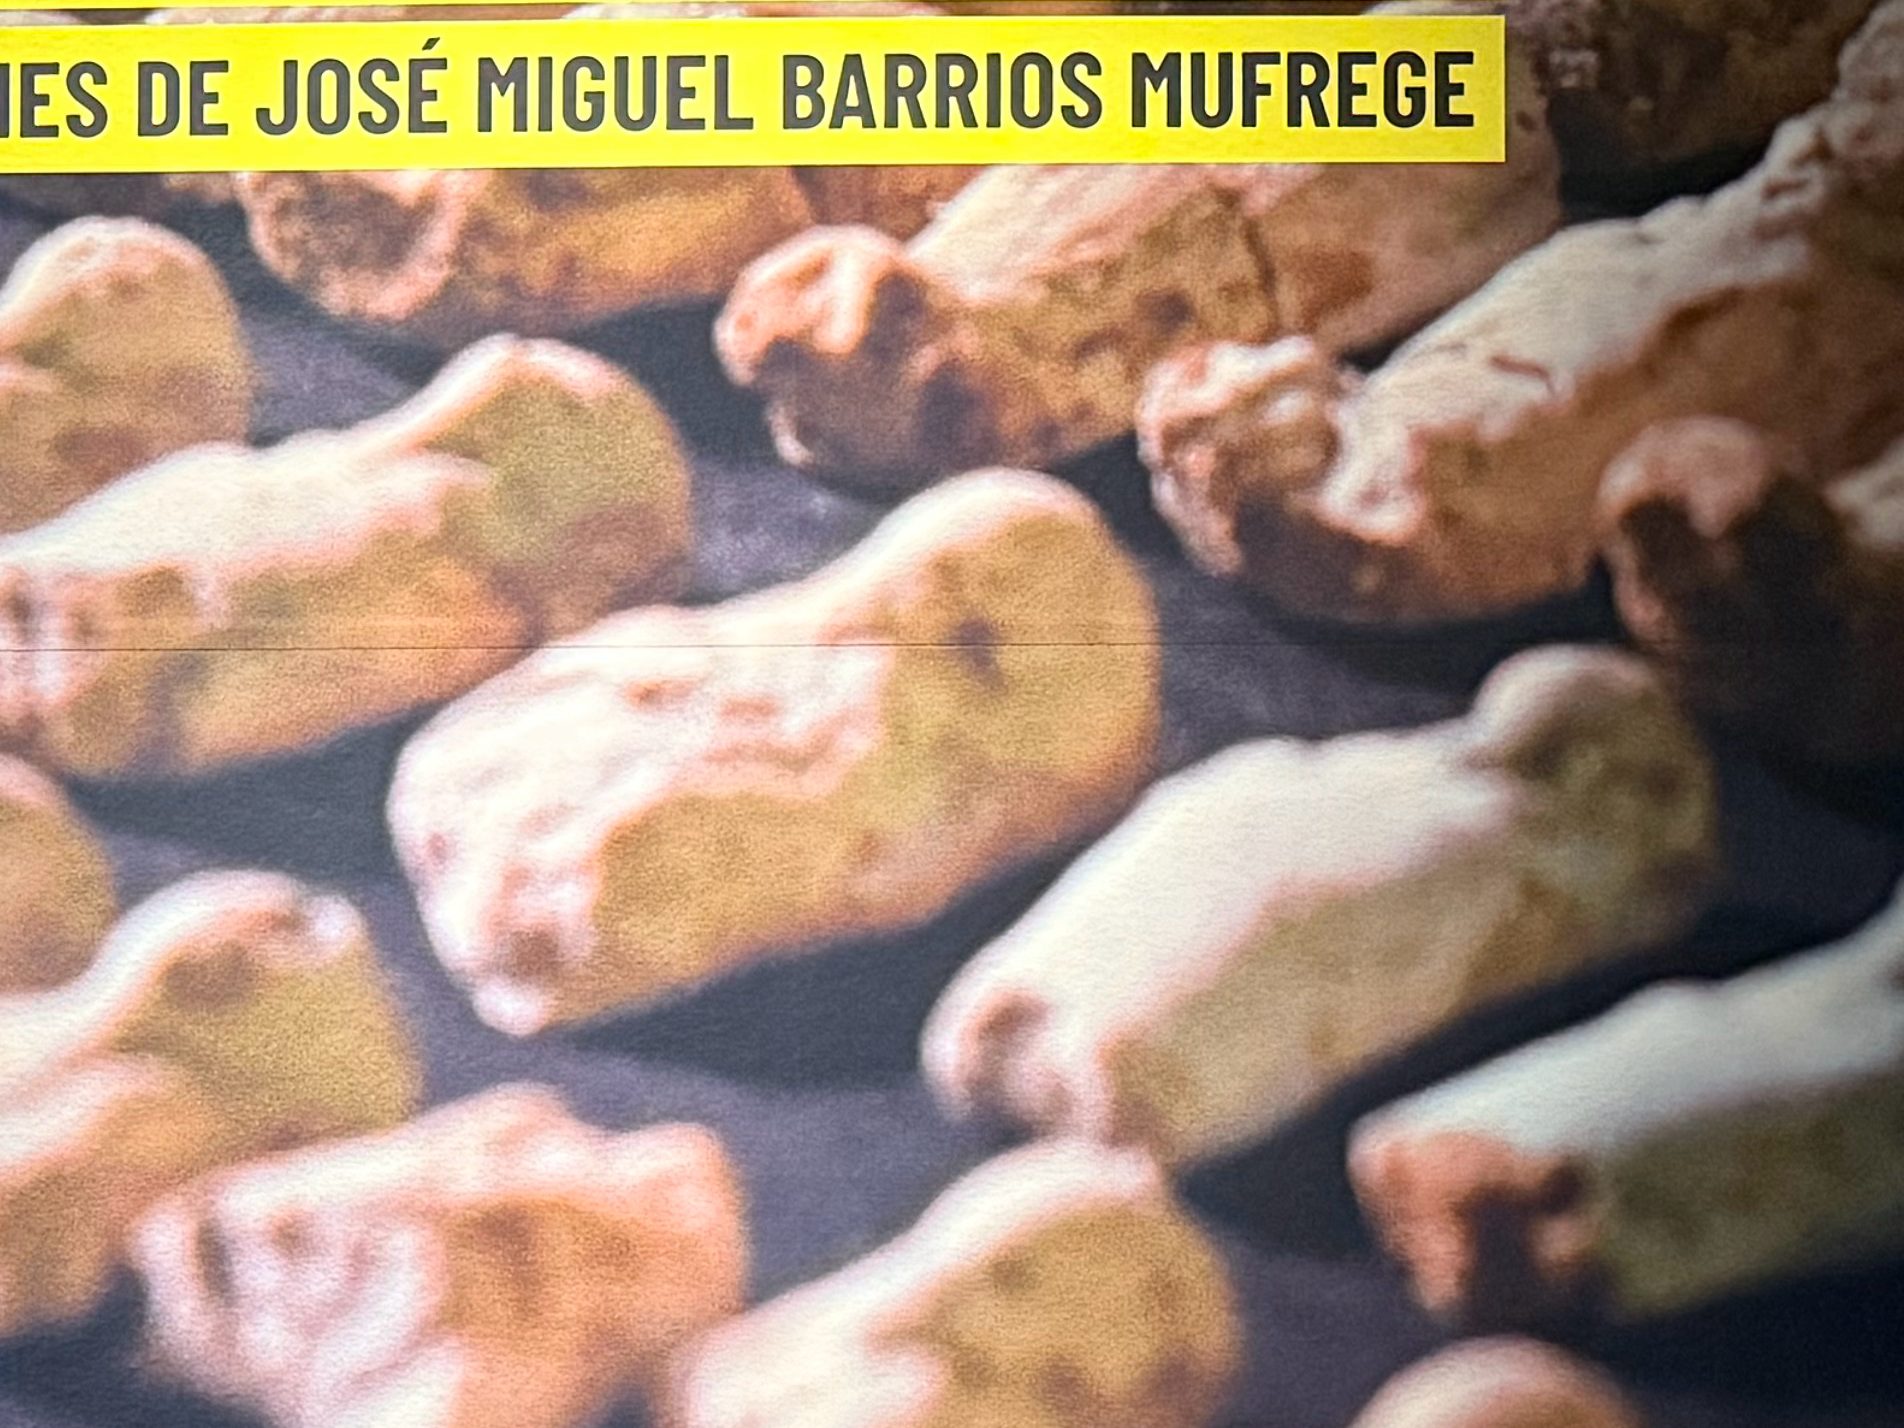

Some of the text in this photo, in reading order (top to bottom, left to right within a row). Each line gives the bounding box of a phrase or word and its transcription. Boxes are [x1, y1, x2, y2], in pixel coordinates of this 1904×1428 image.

[137, 60, 229, 137] DE
[255, 38, 448, 135] JOSÉ
[477, 54, 754, 133] MIGUEL
[782, 52, 1102, 130] BARRIOS
[1131, 50, 1474, 129] MUFREGE
